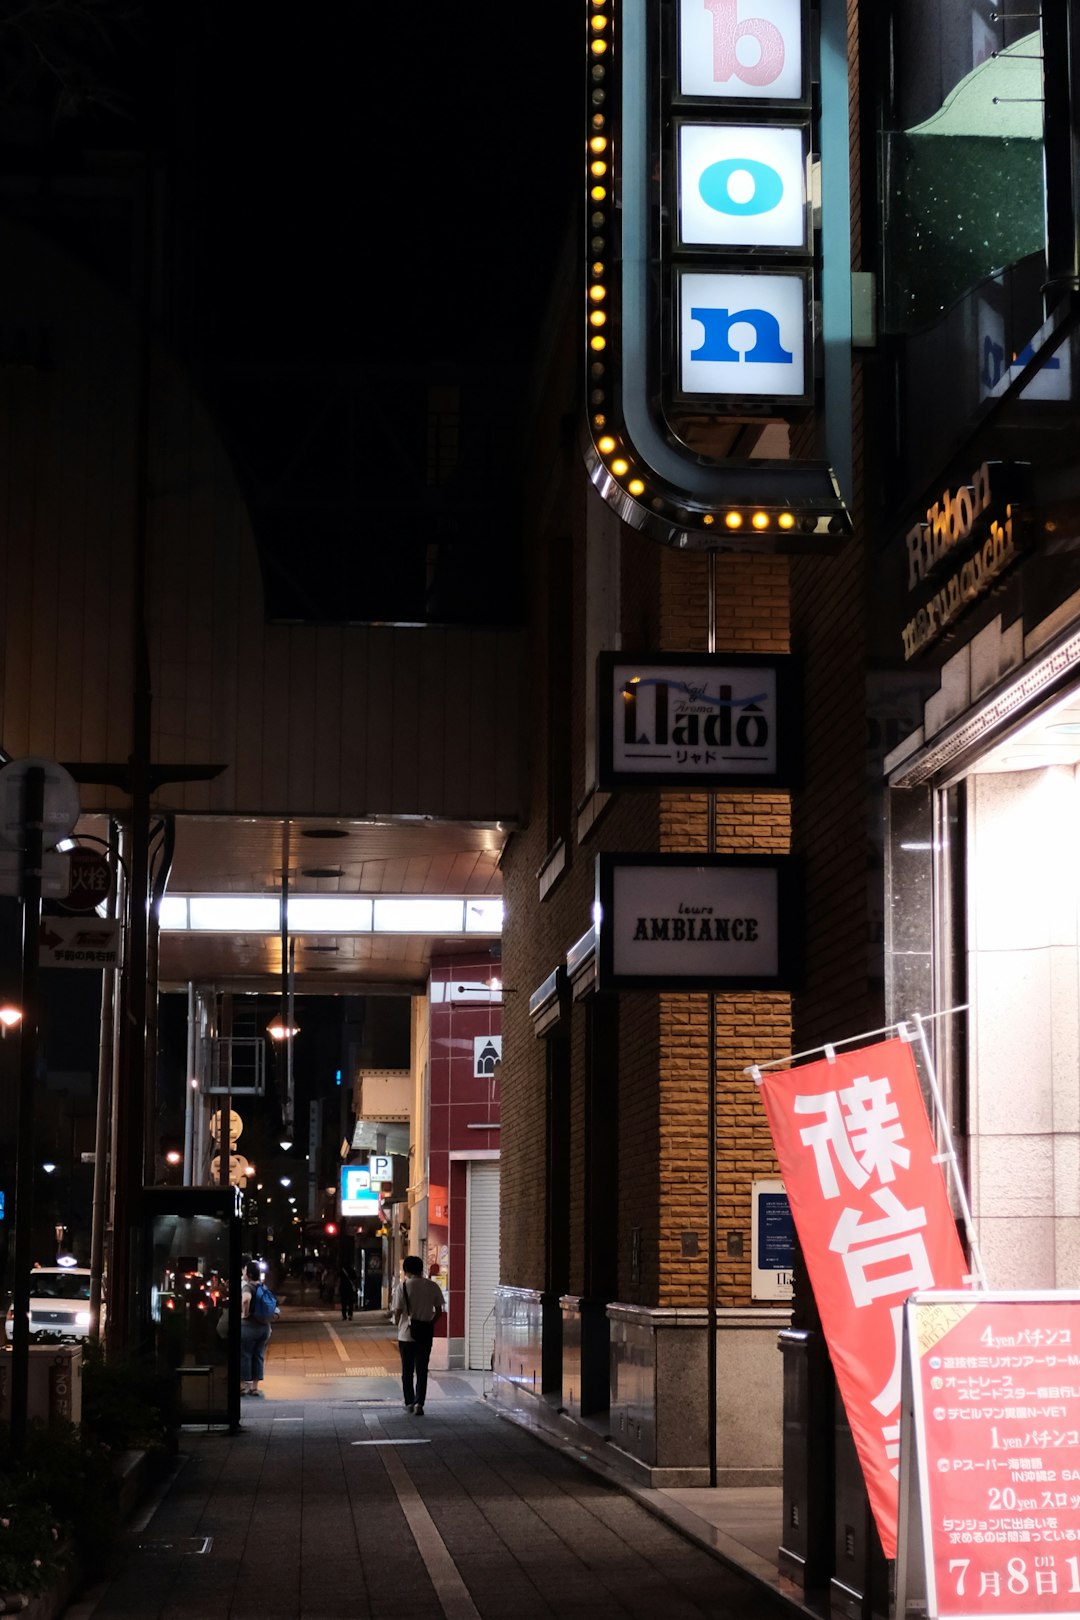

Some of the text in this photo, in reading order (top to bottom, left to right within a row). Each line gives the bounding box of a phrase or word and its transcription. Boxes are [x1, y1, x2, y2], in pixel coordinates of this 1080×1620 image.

[906, 461, 992, 592] Ribbon
[676, 751, 717, 764] リャド
[72, 866, 107, 890] 火栓
[678, 903, 713, 915] leurs
[633, 917, 759, 942] AMBIANCE
[54, 950, 116, 963] 手前の角右折
[375, 1158, 388, 1174] P
[347, 1171, 371, 1199] P
[945, 1376, 1013, 1387] オートレース
[950, 1530, 1080, 1544] 求めるのは間違っている
